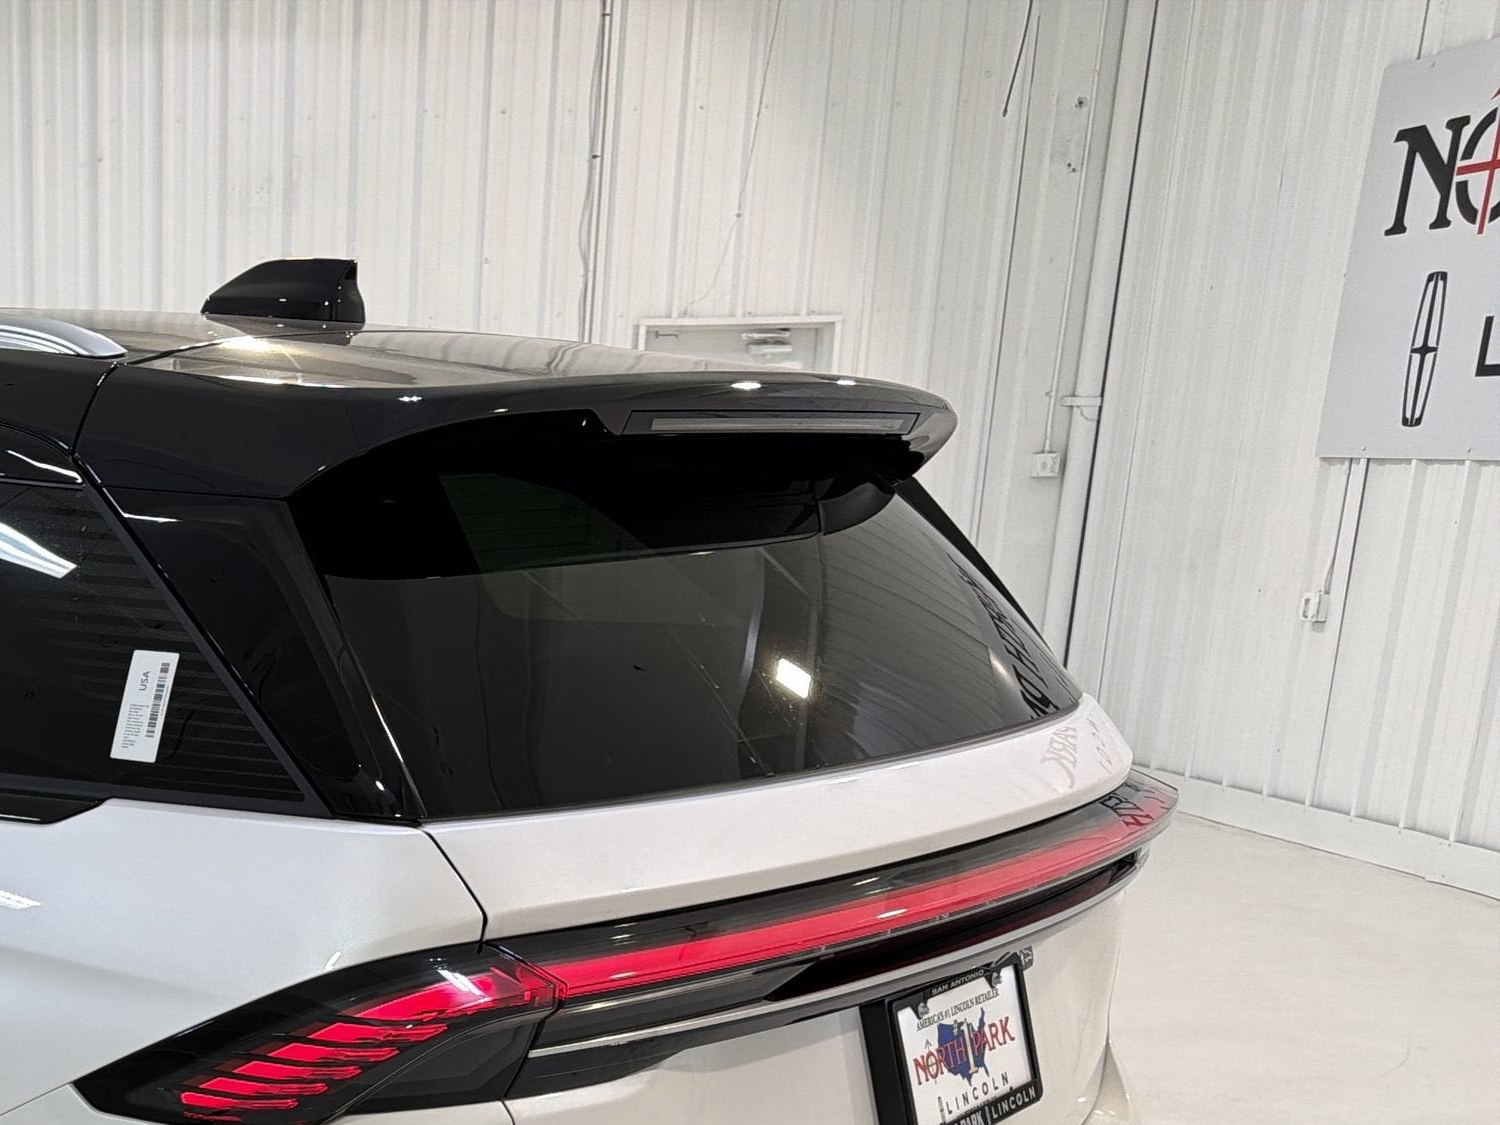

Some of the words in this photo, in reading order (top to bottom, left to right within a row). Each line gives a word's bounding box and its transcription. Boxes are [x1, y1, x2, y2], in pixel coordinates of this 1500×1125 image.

[138, 670, 151, 691] USA
[931, 983, 949, 996] SAN
[949, 969, 985, 991] ANTONIO
[950, 998, 975, 1018] LINCOLN
[913, 1038, 967, 1085] NORTH
[974, 1016, 1015, 1056] PARK
[946, 1072, 1009, 1115] LINCOLN
[991, 1085, 1036, 1119] LINCOLN
